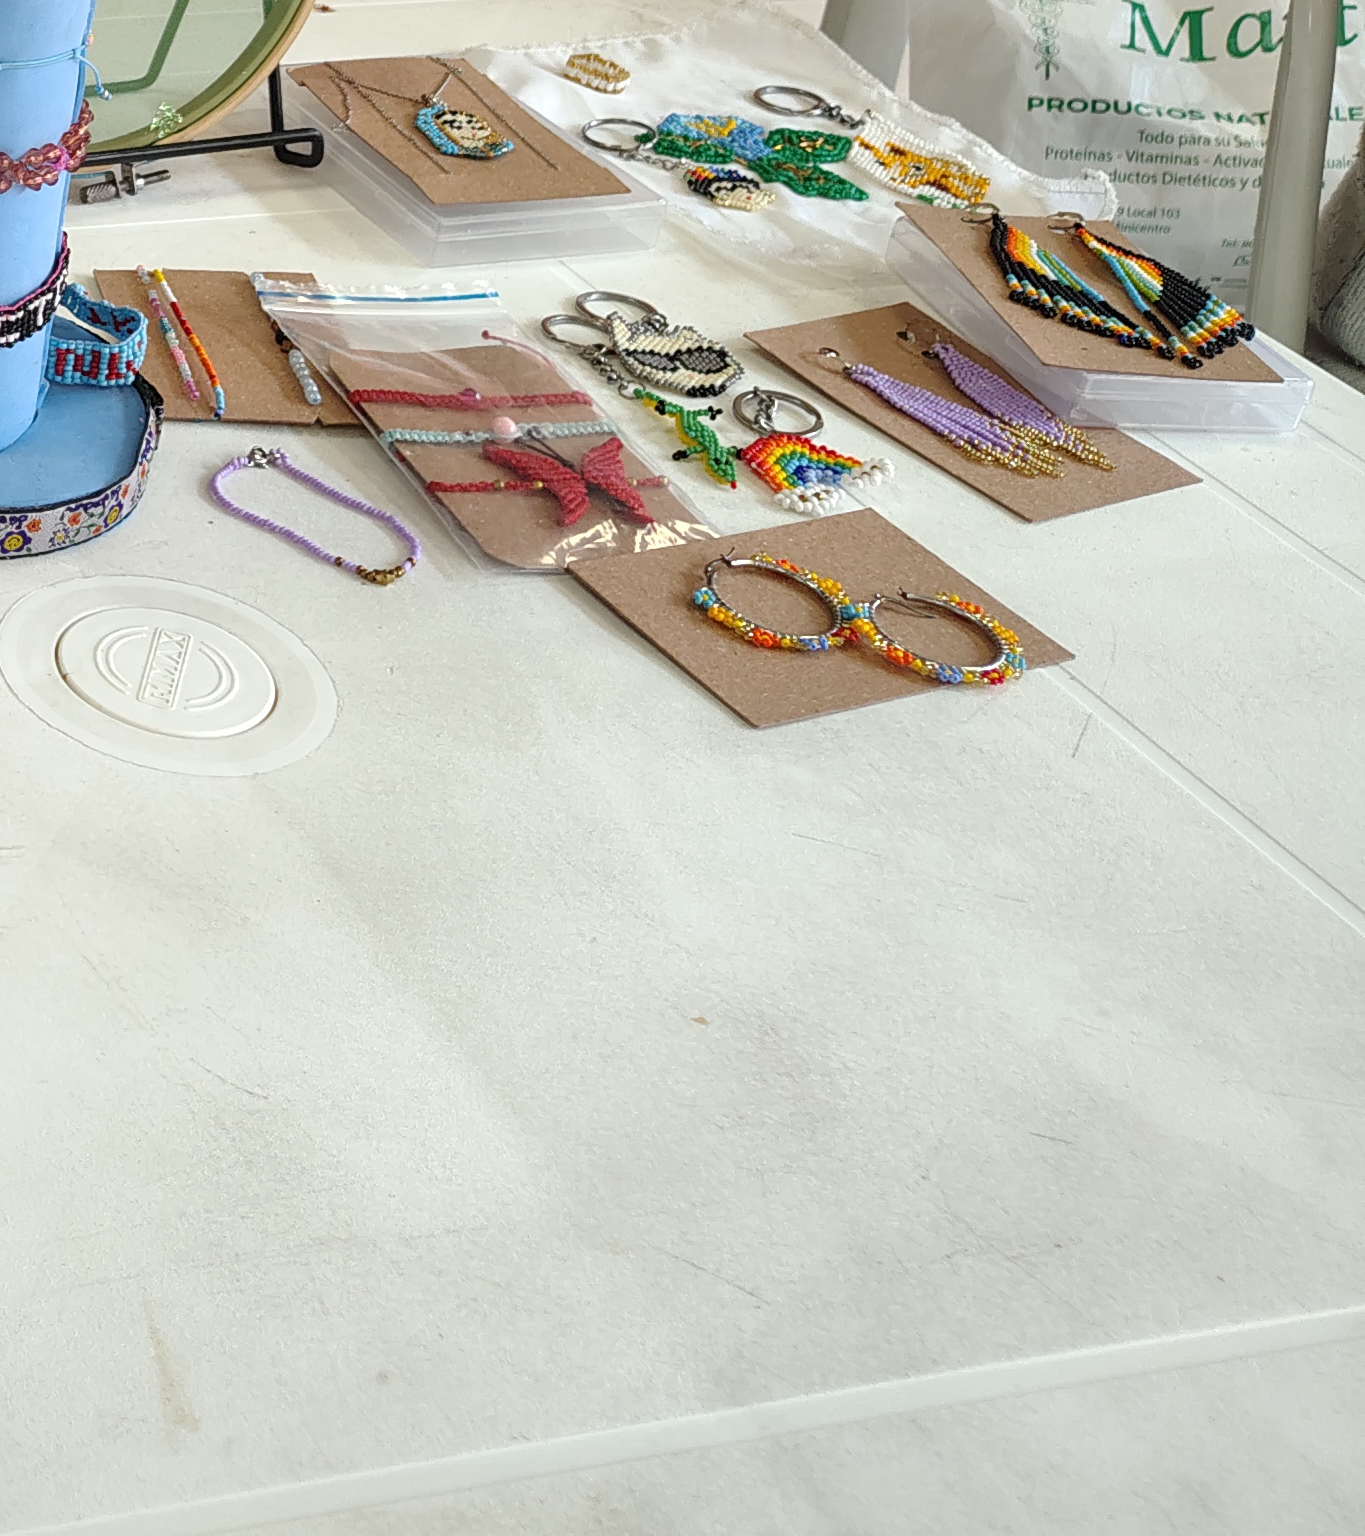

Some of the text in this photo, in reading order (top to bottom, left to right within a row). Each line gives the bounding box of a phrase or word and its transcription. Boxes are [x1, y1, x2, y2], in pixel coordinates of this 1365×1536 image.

[1027, 96, 1206, 121] PRODUCTOS
[1137, 128, 1174, 146] Todo
[1178, 131, 1211, 150] para
[1213, 134, 1231, 148] su
[1045, 145, 1113, 163] Proteínas
[1125, 149, 1200, 167] Vitaminas
[1162, 170, 1237, 189] Dietéticos
[1240, 175, 1250, 191] y
[1127, 205, 1157, 220] Local
